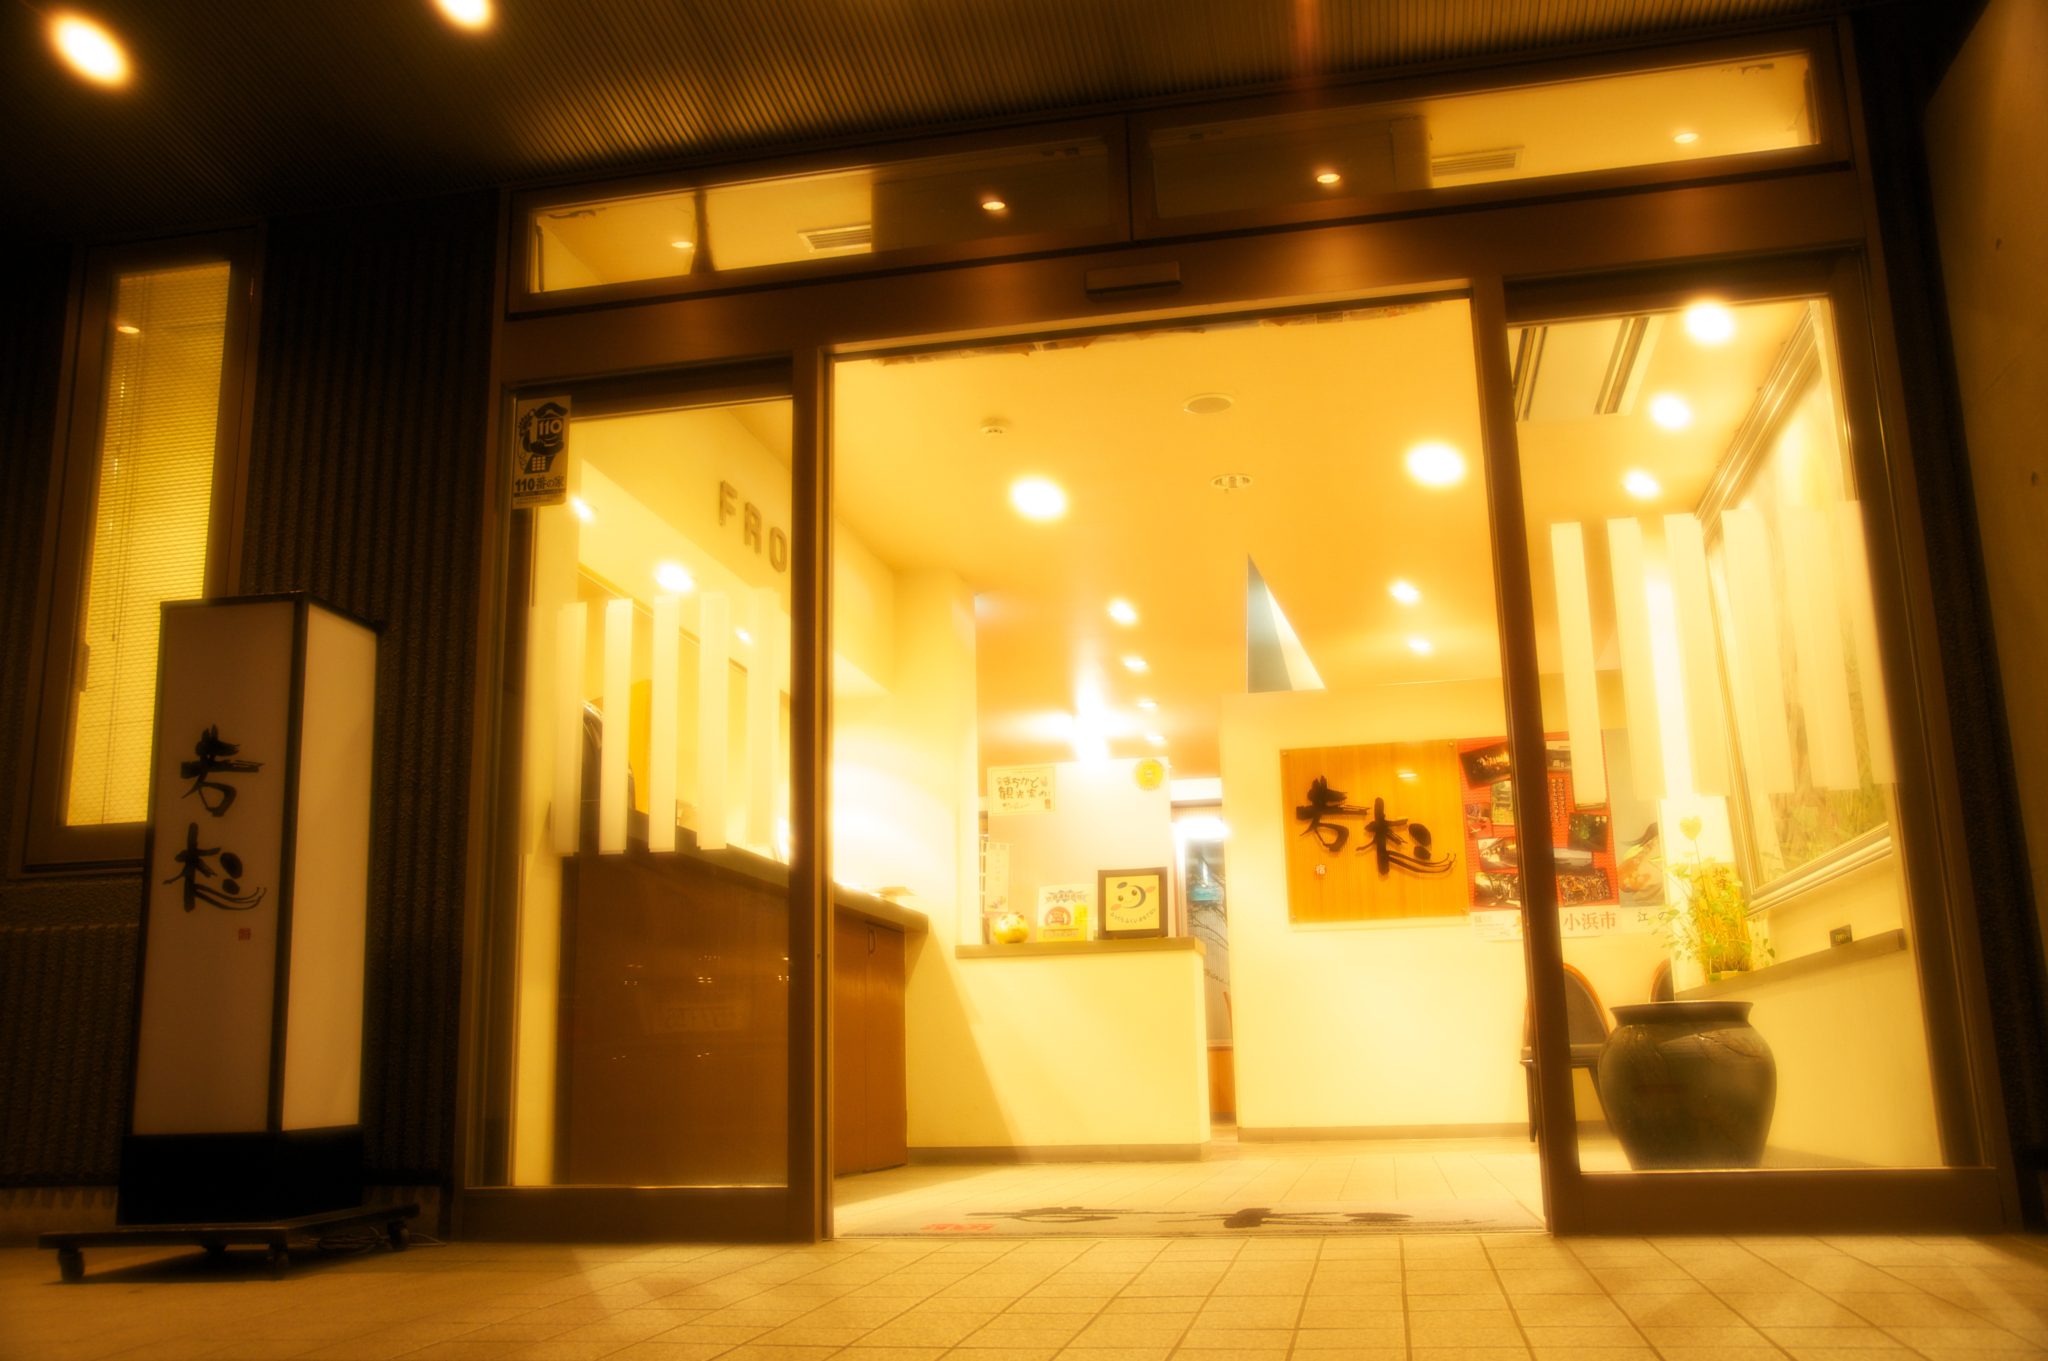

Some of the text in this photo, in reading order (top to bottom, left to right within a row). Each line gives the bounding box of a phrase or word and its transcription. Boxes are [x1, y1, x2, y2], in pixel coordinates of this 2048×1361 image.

[718, 479, 788, 573] FRO
[1563, 912, 1617, 931] 小浜市
